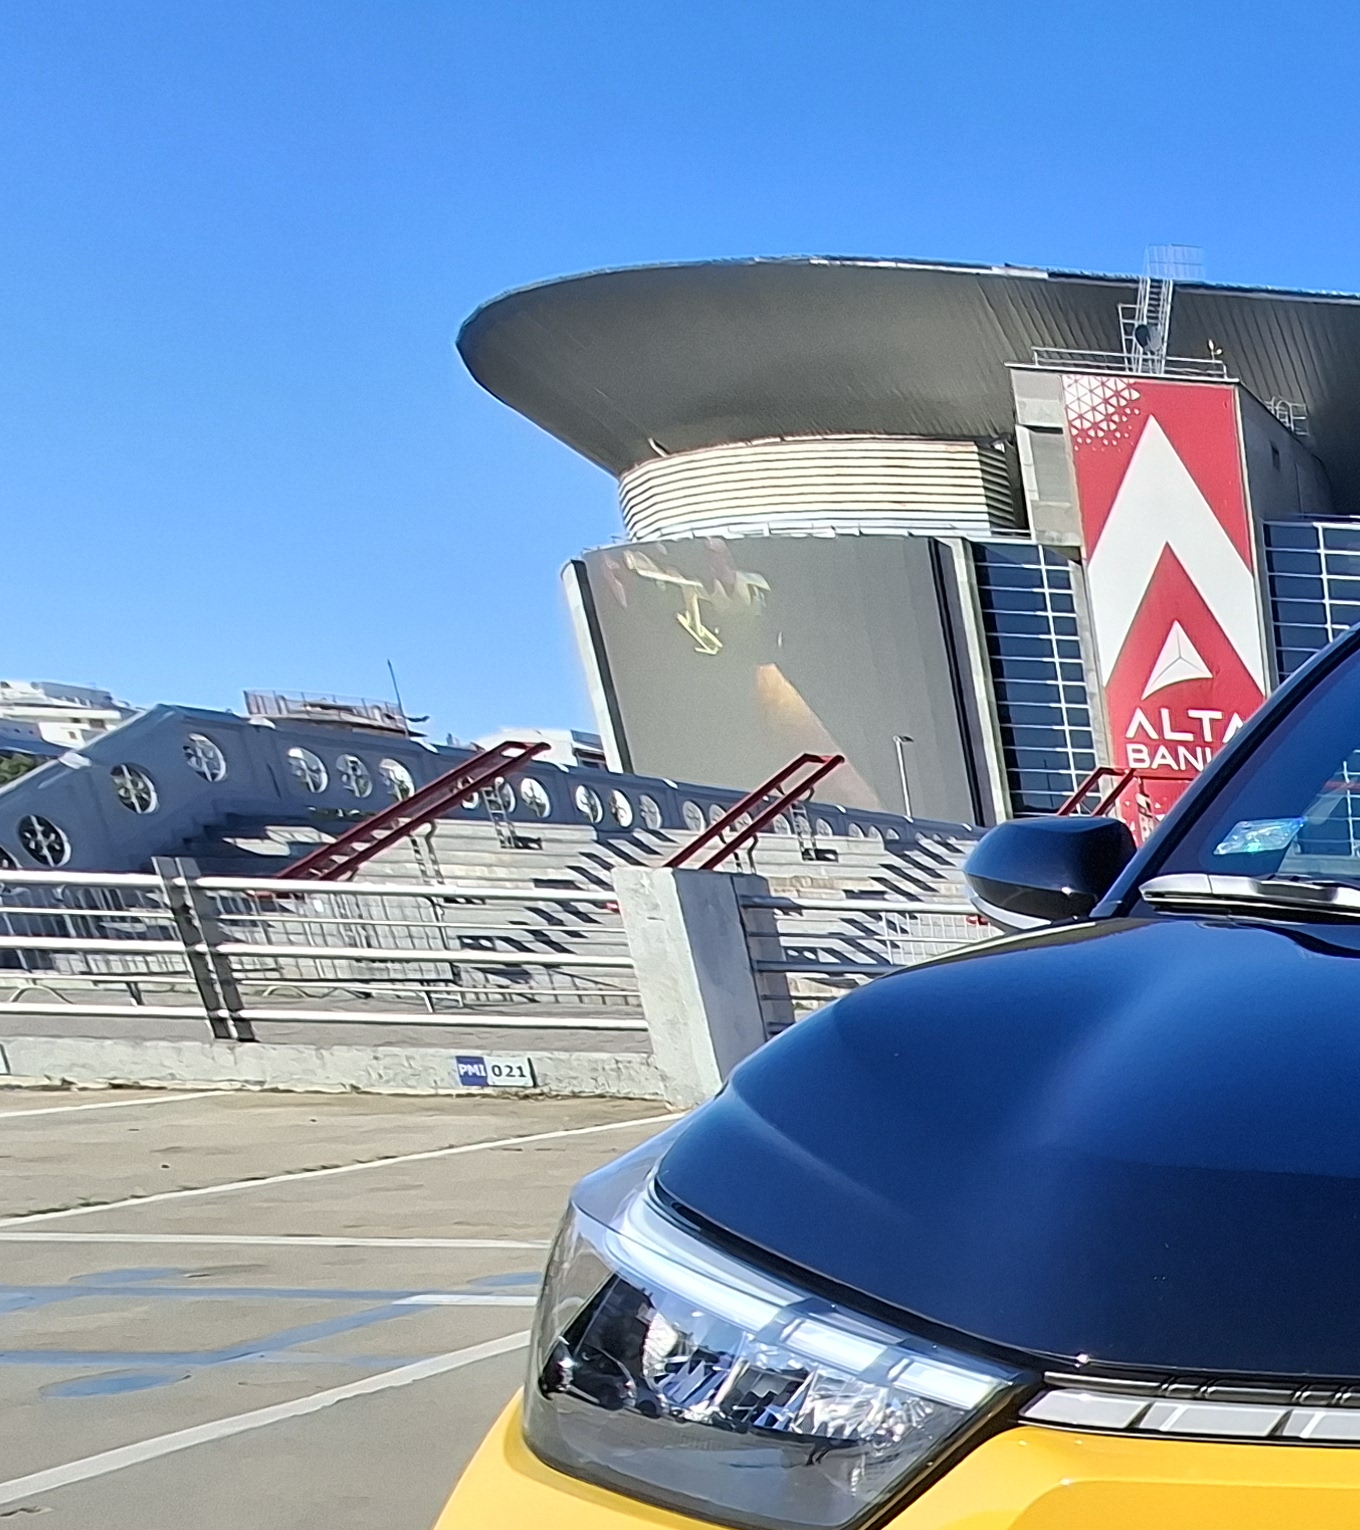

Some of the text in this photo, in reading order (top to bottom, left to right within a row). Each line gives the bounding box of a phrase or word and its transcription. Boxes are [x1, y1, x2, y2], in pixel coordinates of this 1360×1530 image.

[1126, 743, 1212, 772] BAN
[458, 1063, 527, 1078] PMI 021
